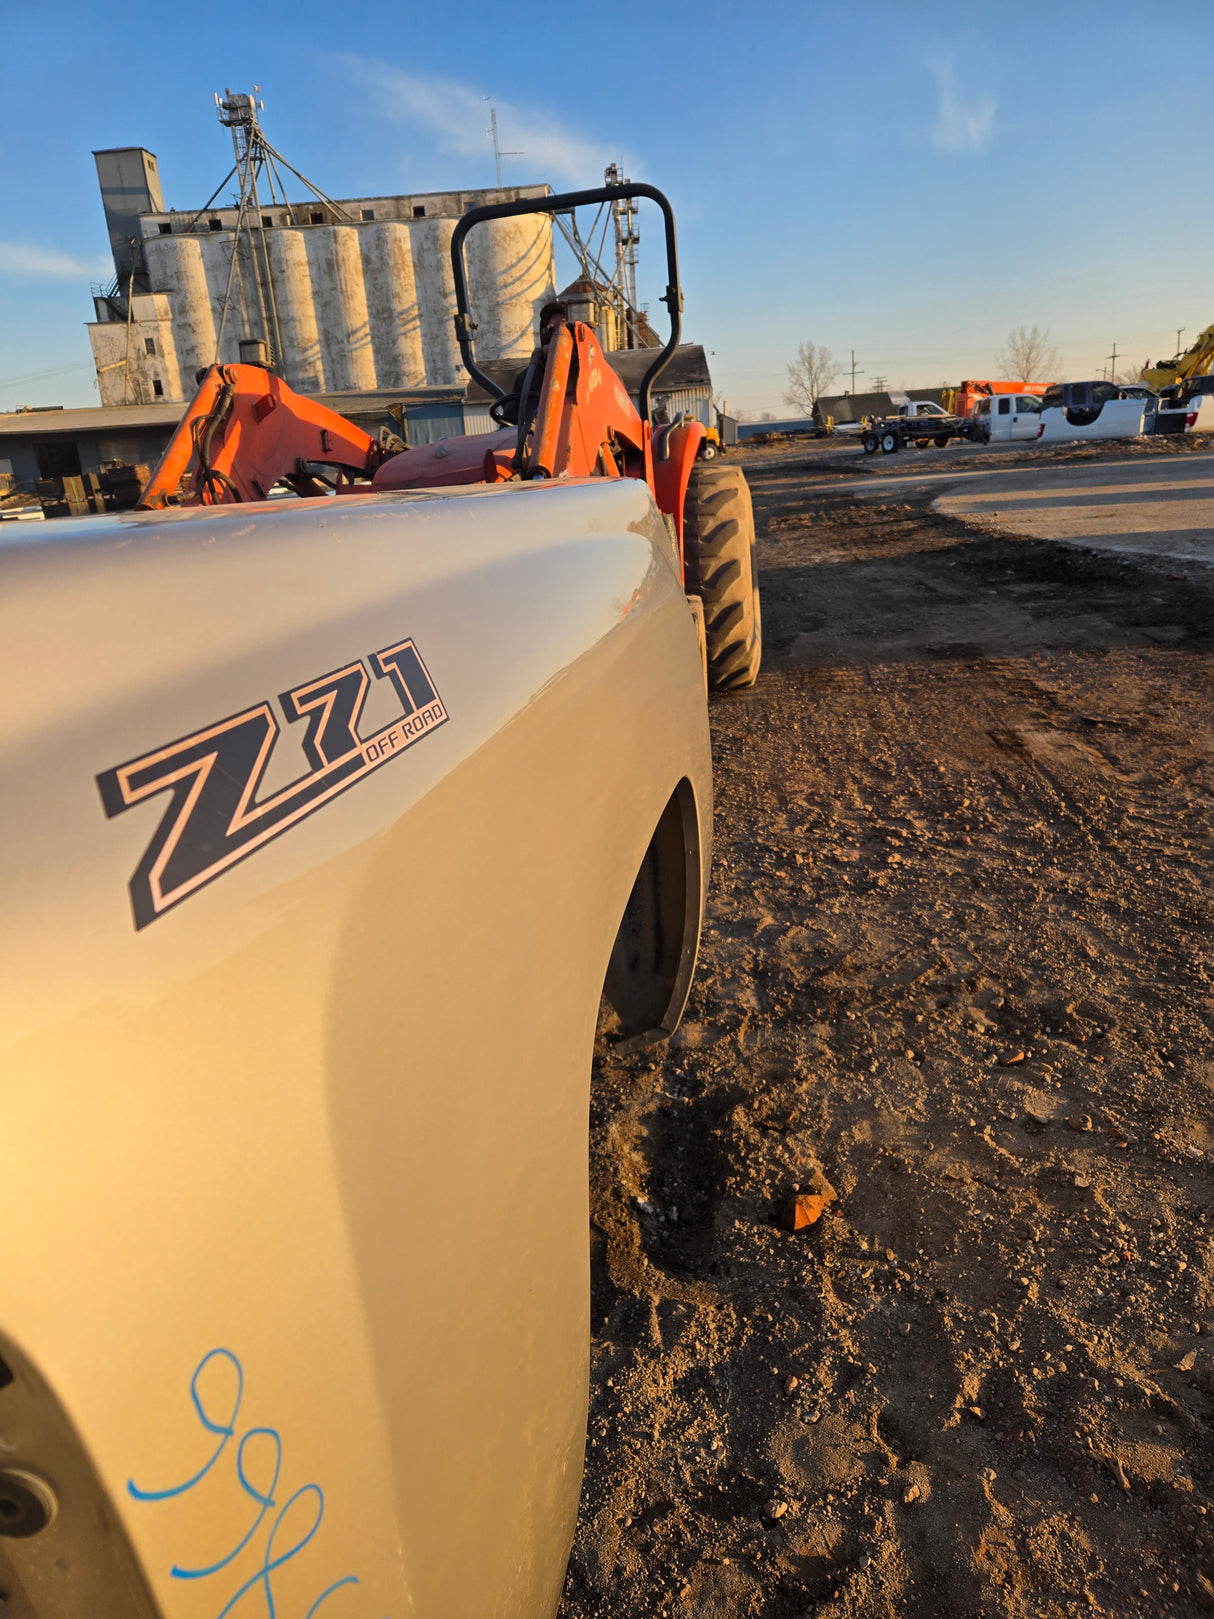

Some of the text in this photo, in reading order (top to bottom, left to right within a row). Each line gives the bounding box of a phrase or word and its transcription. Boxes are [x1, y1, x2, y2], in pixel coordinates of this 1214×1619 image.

[95, 637, 446, 932] Z71
[365, 704, 443, 762] OFF ROAD
